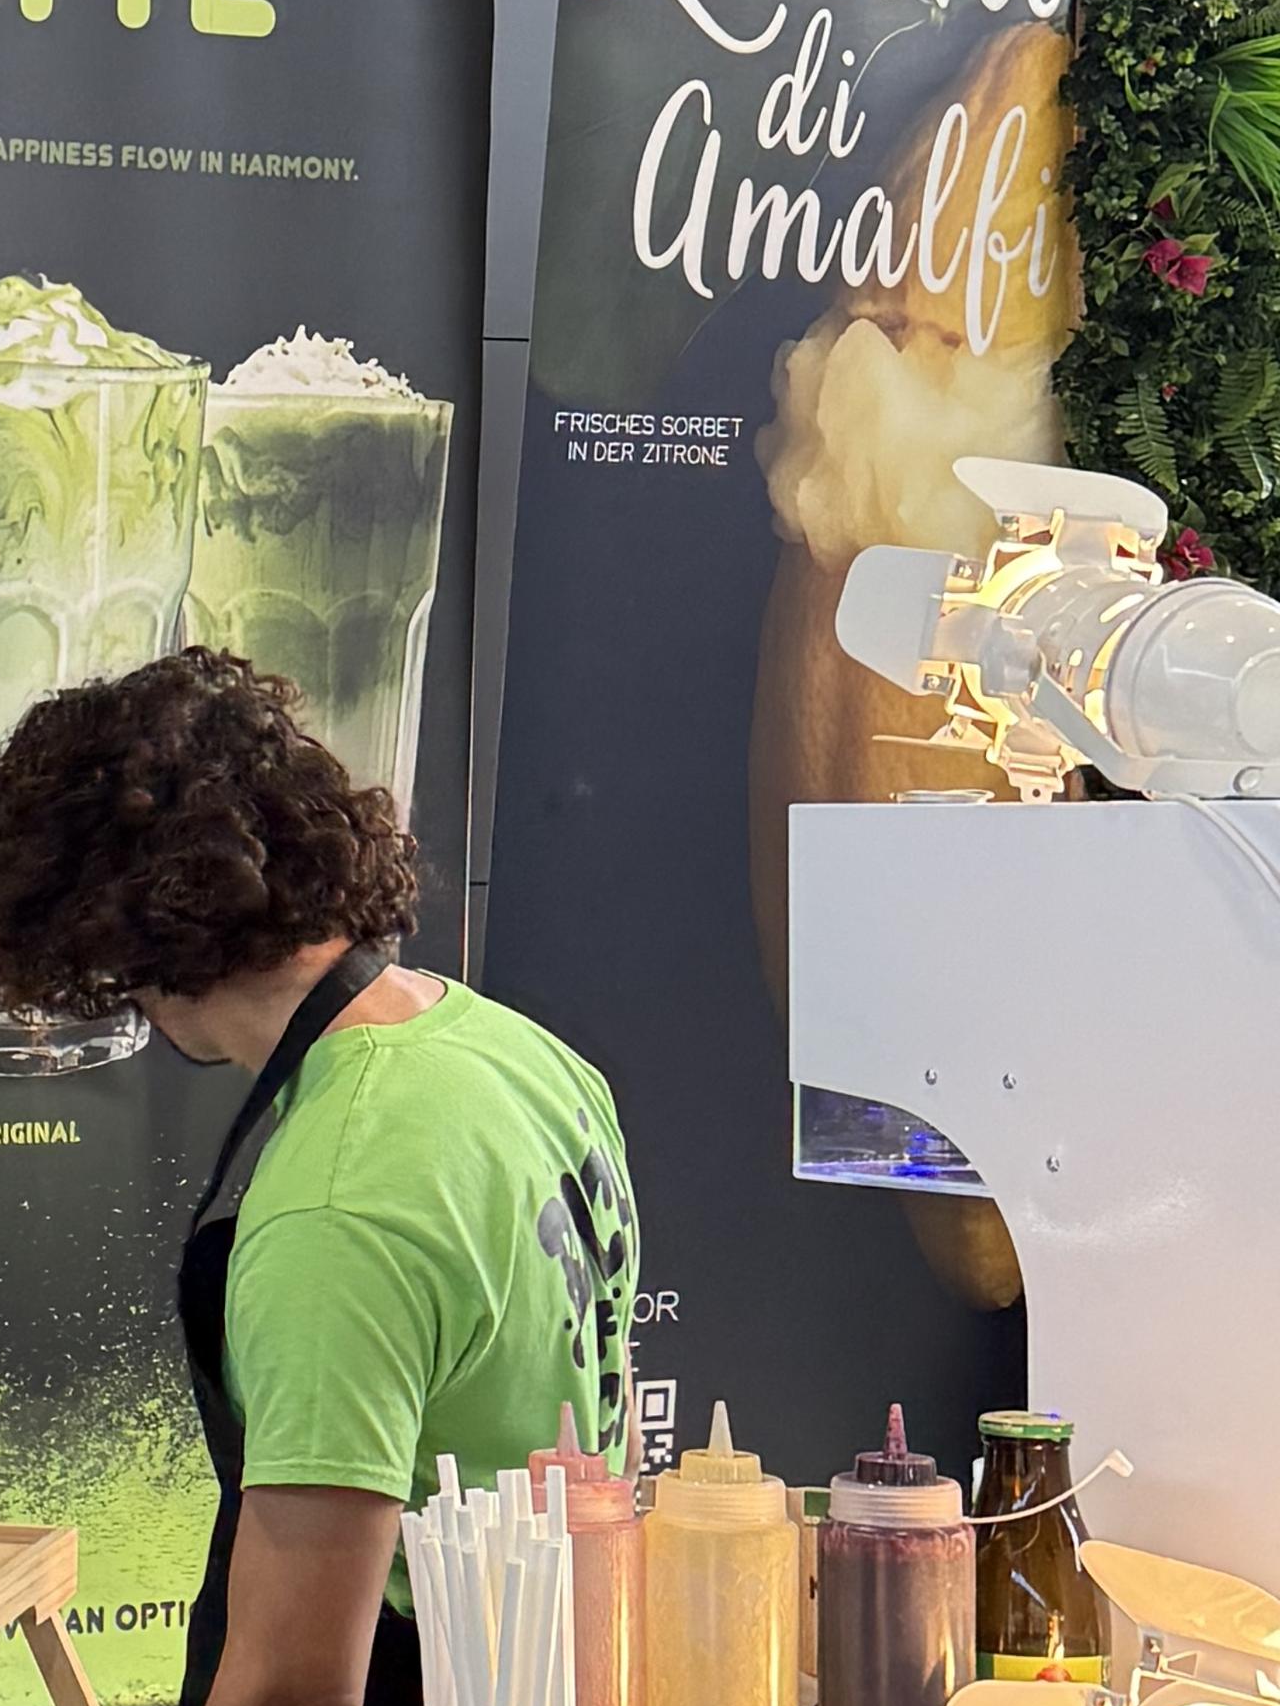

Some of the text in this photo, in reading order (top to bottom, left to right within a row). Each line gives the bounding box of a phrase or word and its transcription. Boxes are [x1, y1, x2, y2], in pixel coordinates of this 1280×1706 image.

[758, 8, 866, 159] di
[121, 145, 193, 172] FLOW
[199, 150, 223, 174] IN
[230, 152, 360, 181] HARMONY.
[633, 78, 1057, 357] Amalfi
[554, 412, 744, 438] FRISCHES SORBET
[568, 442, 730, 466] IN DER ZITRONE
[115, 1600, 196, 1631] OPTI
